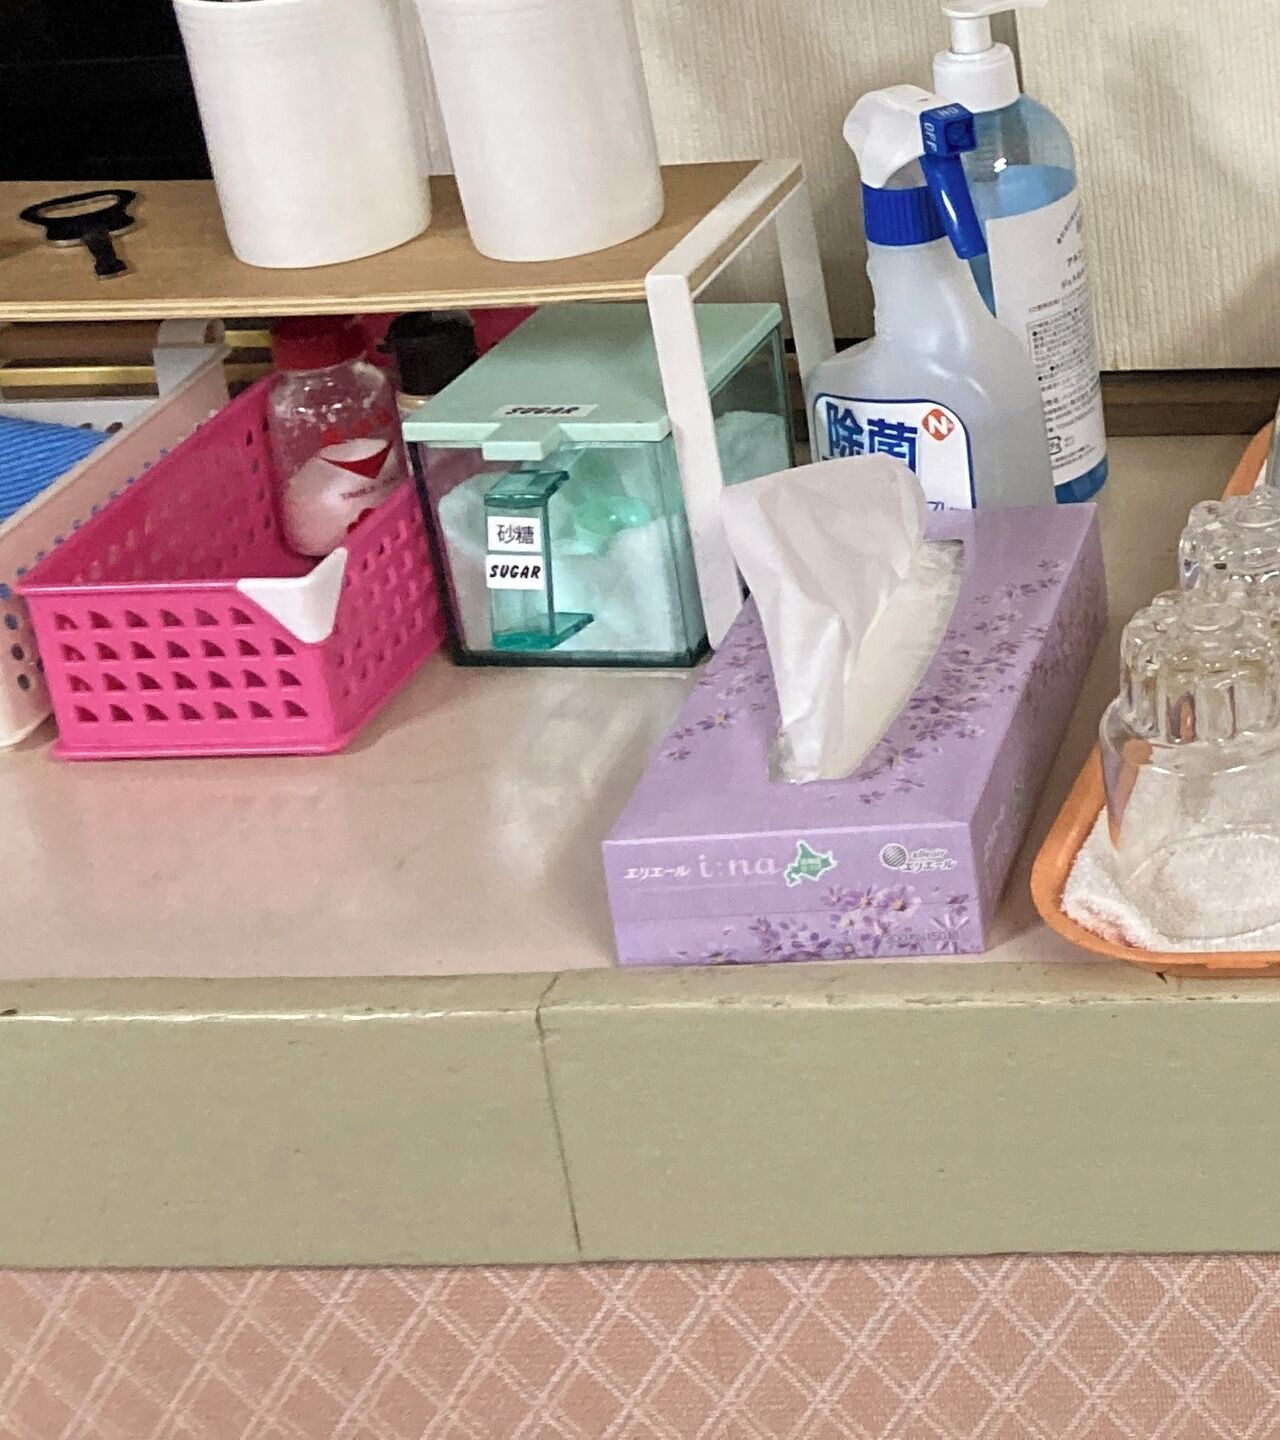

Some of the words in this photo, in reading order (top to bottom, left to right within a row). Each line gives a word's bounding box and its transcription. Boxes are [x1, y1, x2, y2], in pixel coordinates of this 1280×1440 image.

[924, 122, 938, 153] OFF
[505, 407, 580, 415] SUGAR
[496, 524, 535, 545] 砂糖
[489, 564, 541, 579] SUGAR
[623, 864, 691, 881] エリエール
[902, 859, 956, 873] エリエール
